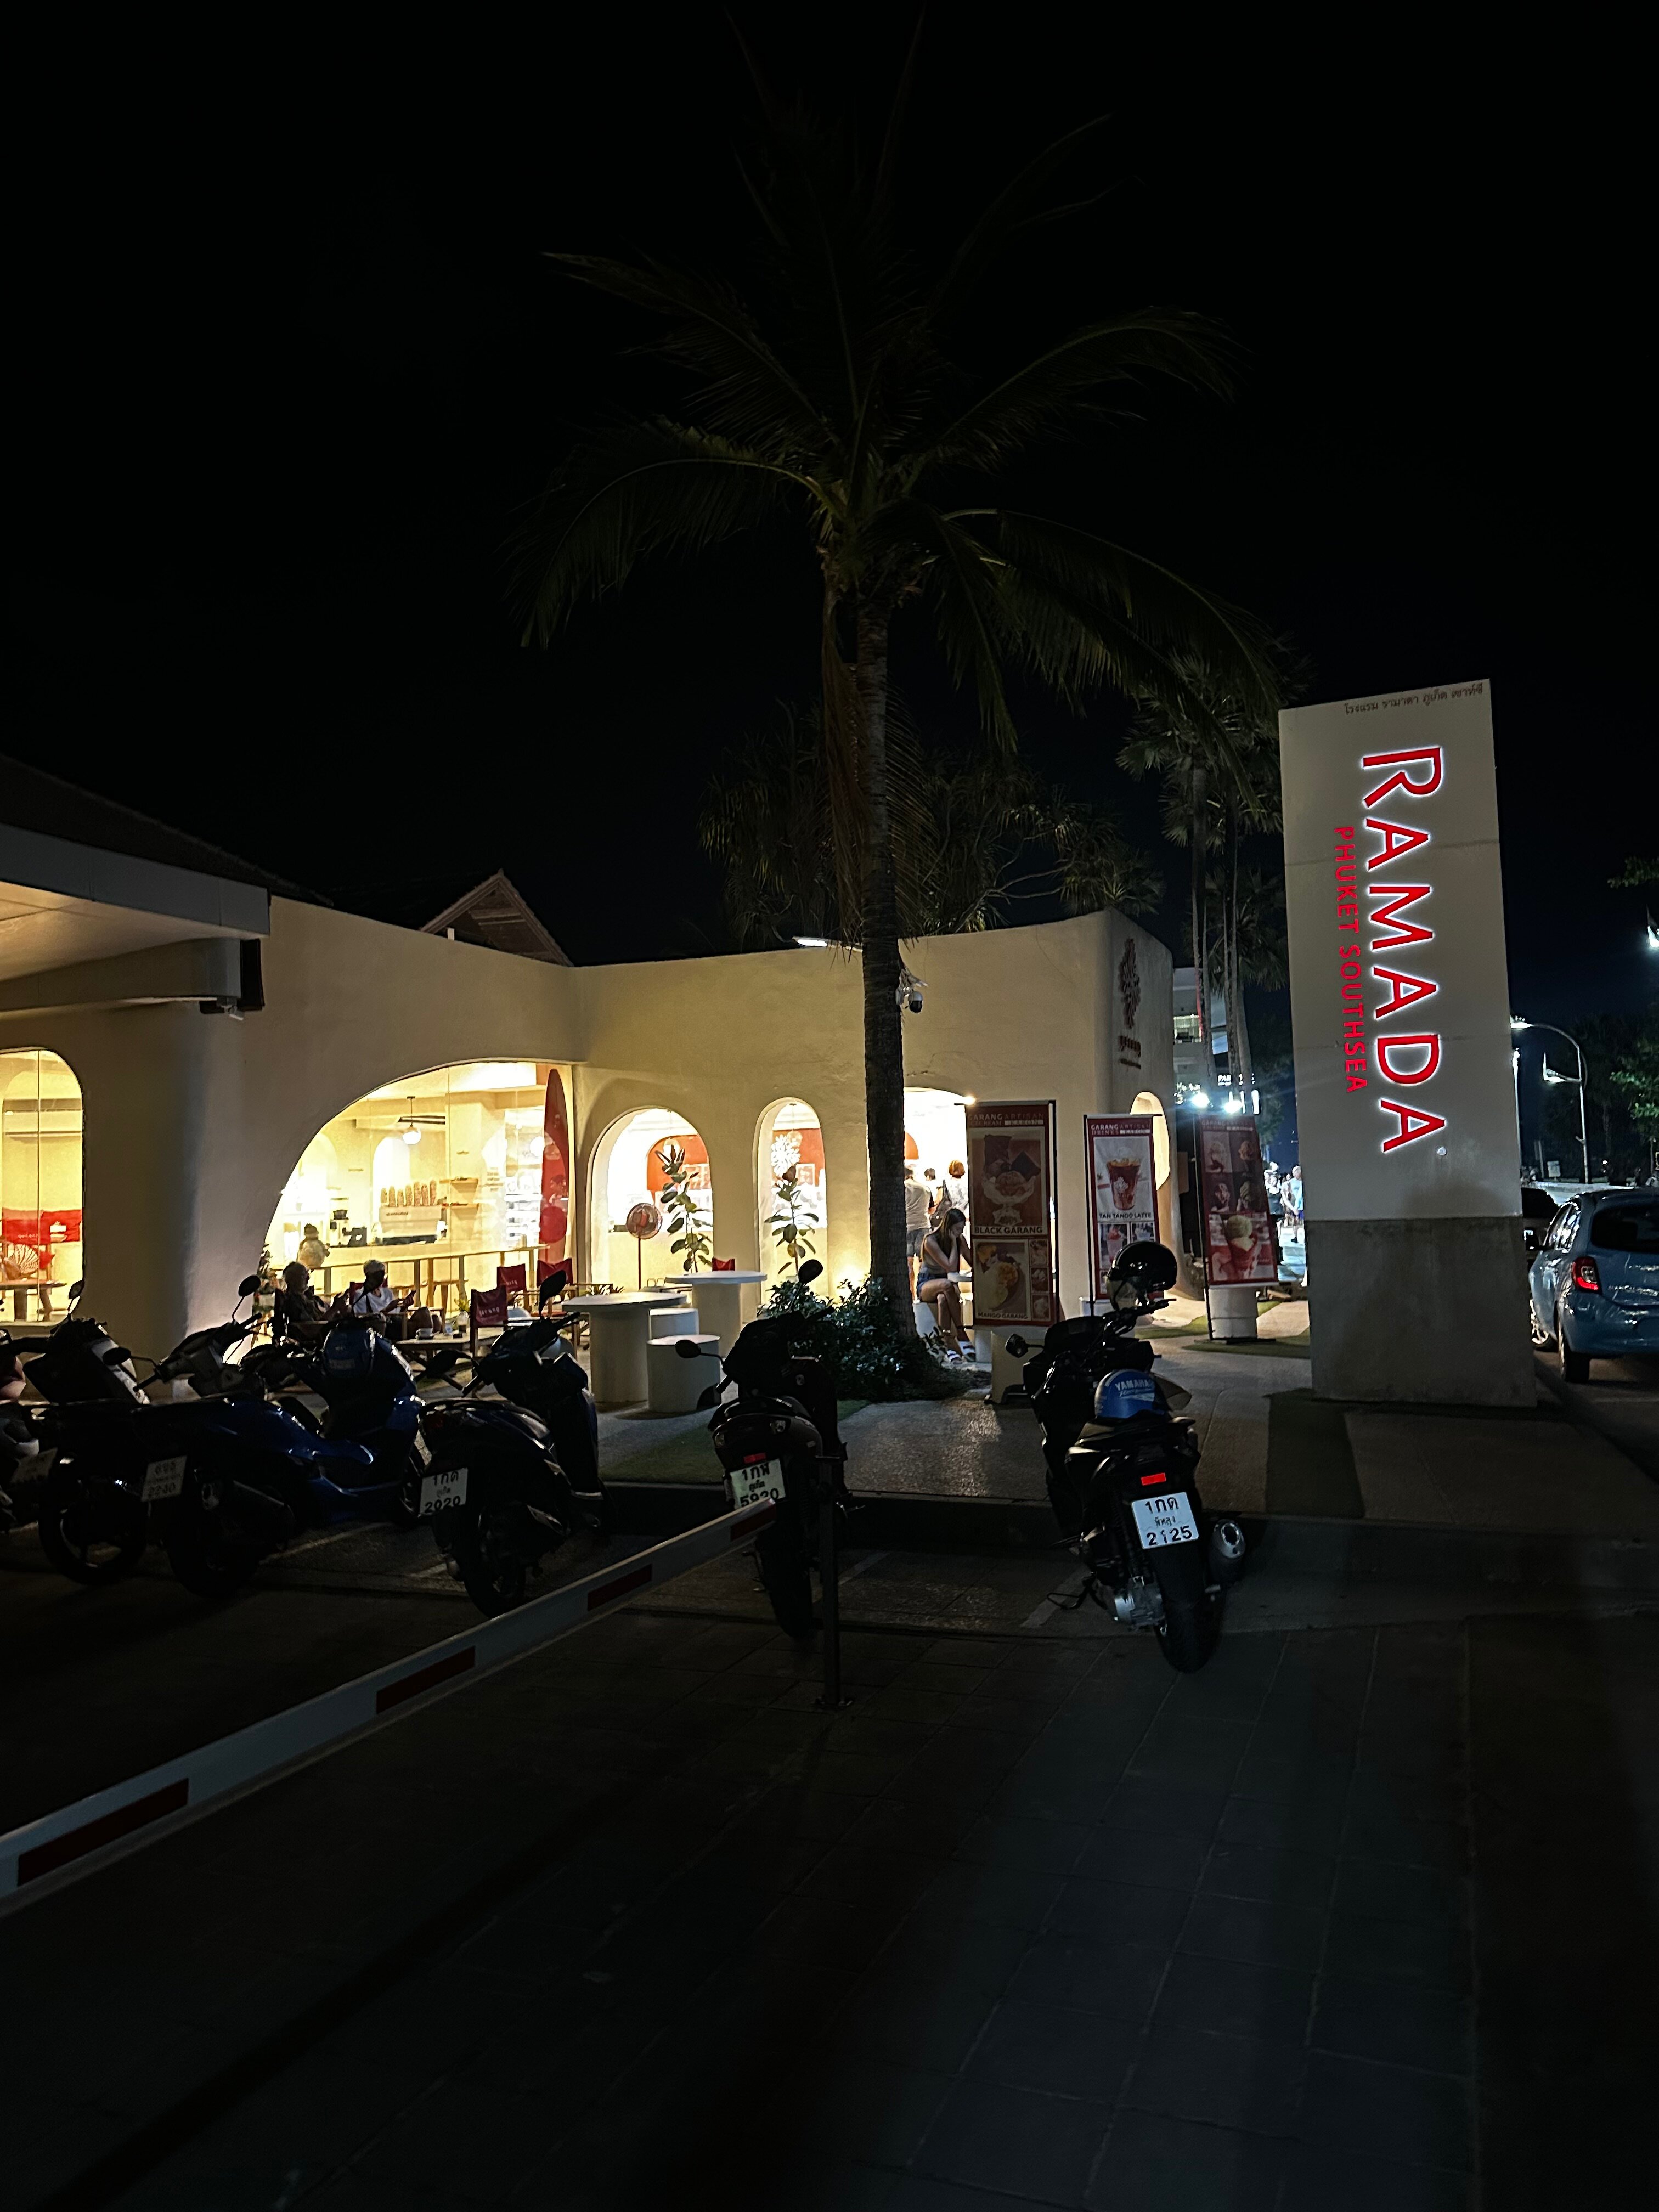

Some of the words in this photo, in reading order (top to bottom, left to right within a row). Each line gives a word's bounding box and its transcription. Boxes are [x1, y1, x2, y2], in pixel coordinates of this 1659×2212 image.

[1334, 826, 1359, 933] PHUKET
[1363, 747, 1446, 1152] RAMADA
[1339, 945, 1367, 1093] SOUTHSEA
[1115, 1379, 1150, 1391] YAMAHA
[425, 1496, 461, 1513] 2020
[1147, 1525, 1192, 1546] 2125
